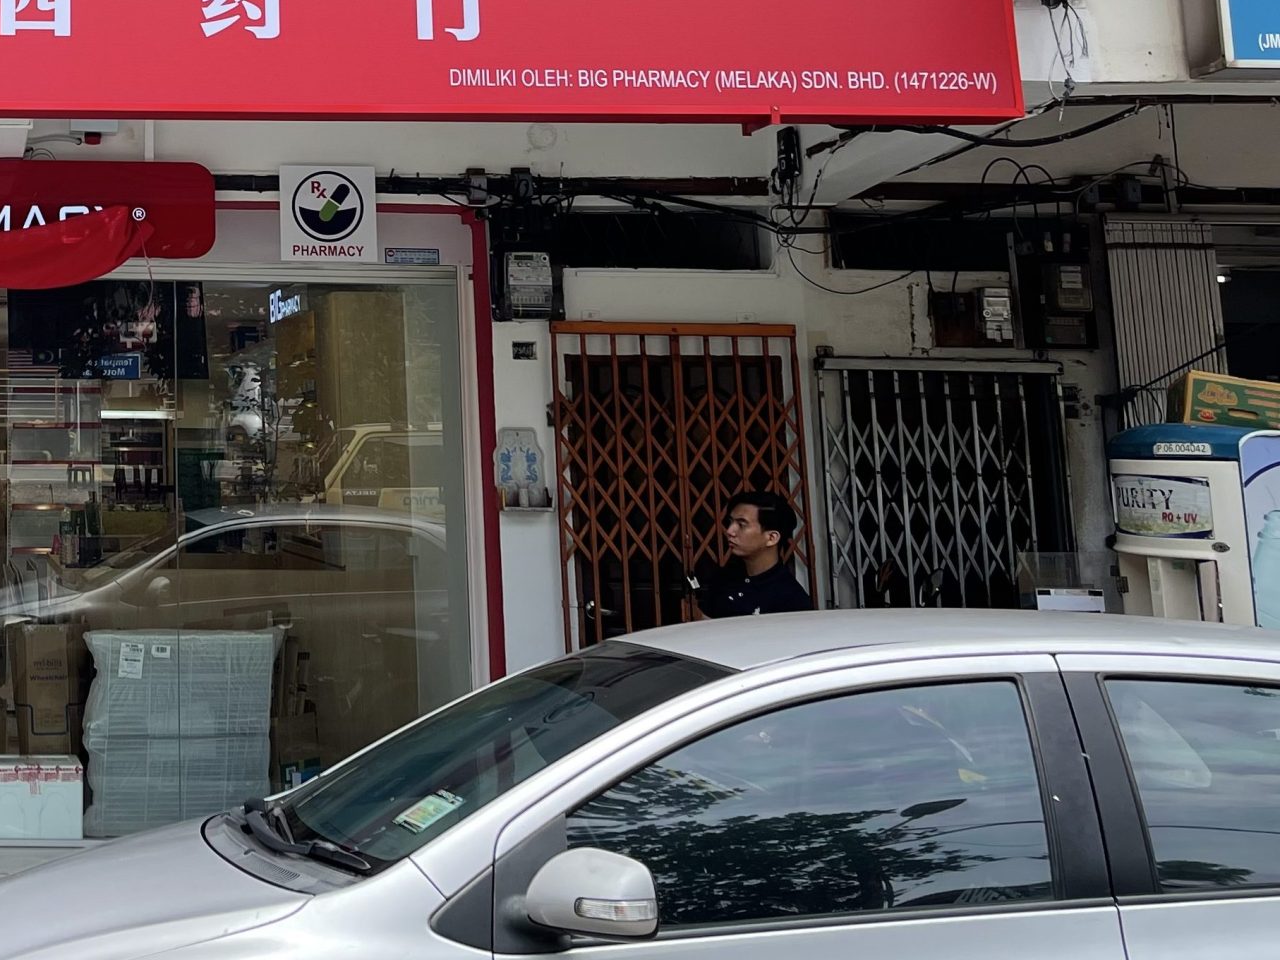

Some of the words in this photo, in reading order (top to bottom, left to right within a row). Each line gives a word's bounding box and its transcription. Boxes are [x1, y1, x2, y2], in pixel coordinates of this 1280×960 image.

[449, 68, 517, 87] DIMILIKI
[521, 69, 573, 87] OLEH:
[578, 70, 608, 87] BIG
[613, 70, 711, 88] PHARMACY
[715, 71, 797, 93] (MELAKA)
[801, 72, 843, 89] SDN.
[848, 73, 889, 90] BHD.
[894, 72, 997, 94] (1471226-W)
[292, 245, 365, 257] PHARMACY
[1183, 513, 1198, 524] UV
